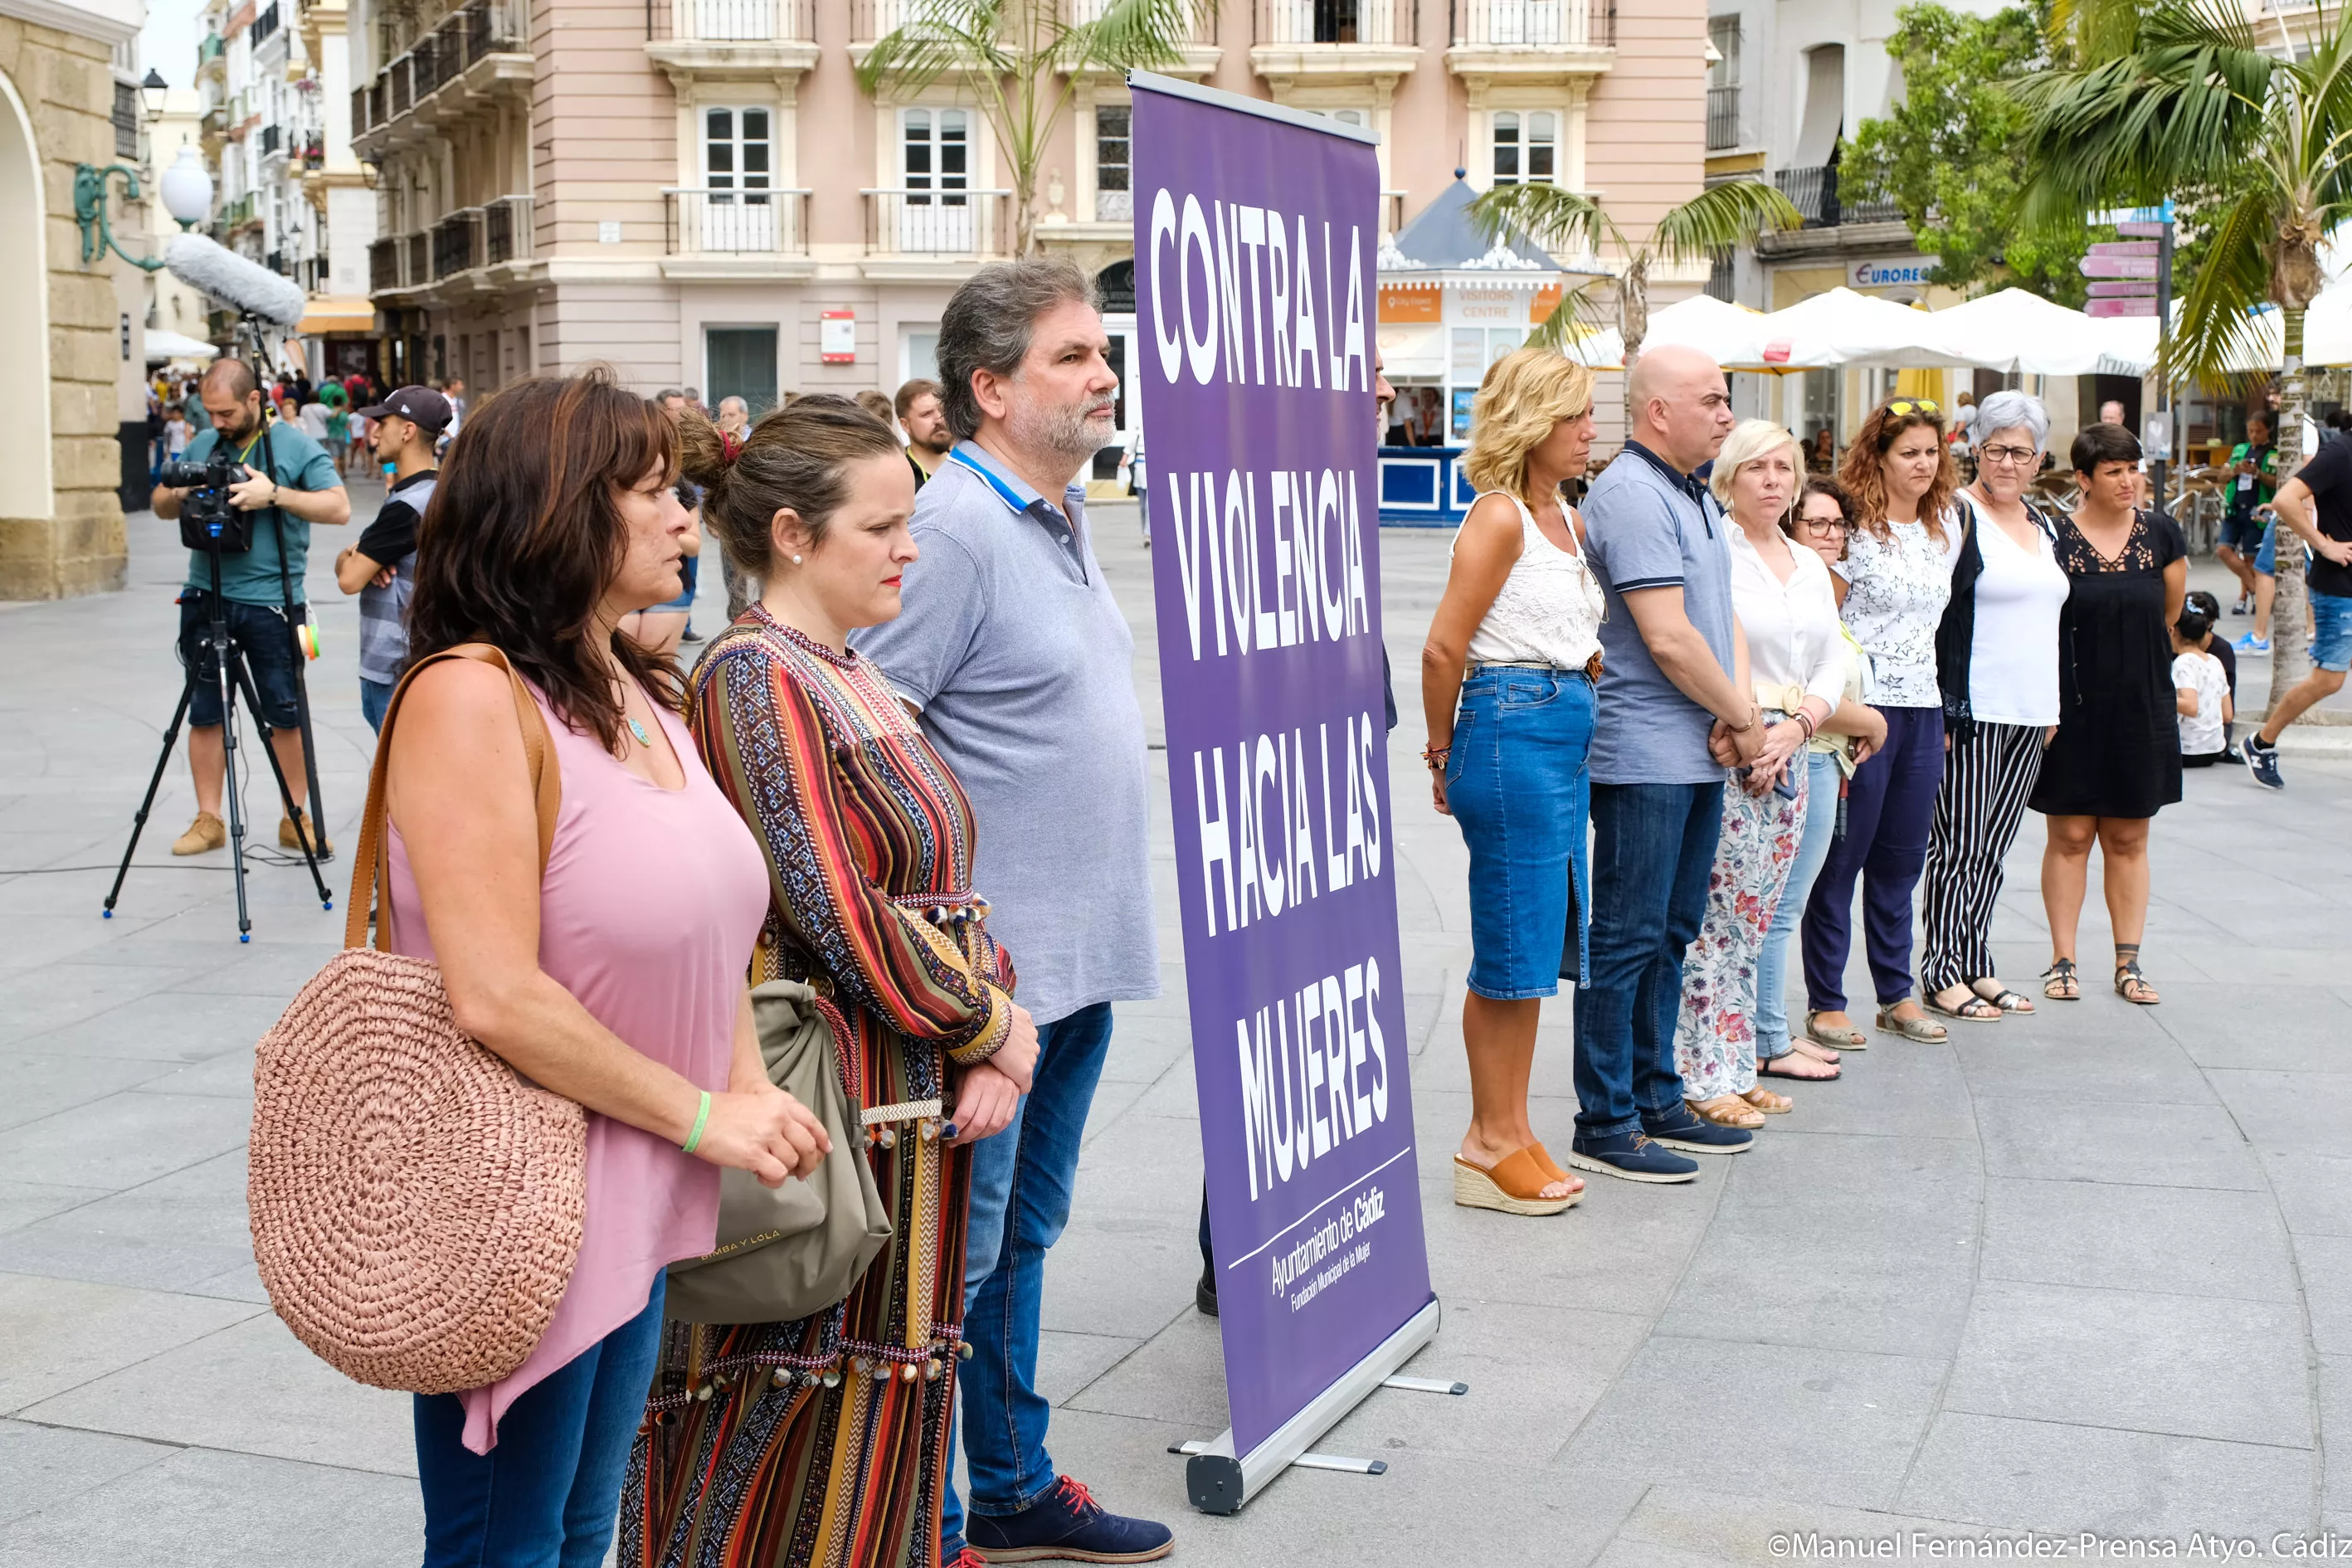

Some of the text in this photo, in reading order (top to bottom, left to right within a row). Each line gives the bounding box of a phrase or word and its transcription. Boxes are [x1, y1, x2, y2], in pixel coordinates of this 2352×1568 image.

[1151, 187, 1368, 392] CONTRA LA
[1459, 290, 1514, 301] VISITORS
[1463, 307, 1509, 318] CENTRE
[1168, 468, 1369, 661] VIOLENCIA
[1194, 711, 1381, 937] HACIA LAS
[1236, 956, 1388, 1202] MUJERES
[750, 1230, 780, 1244] LOLA
[1272, 1186, 1385, 1298] Ayuntamiento de Cádiz
[1291, 1241, 1371, 1313] Fundación Municipal de la Mujer
